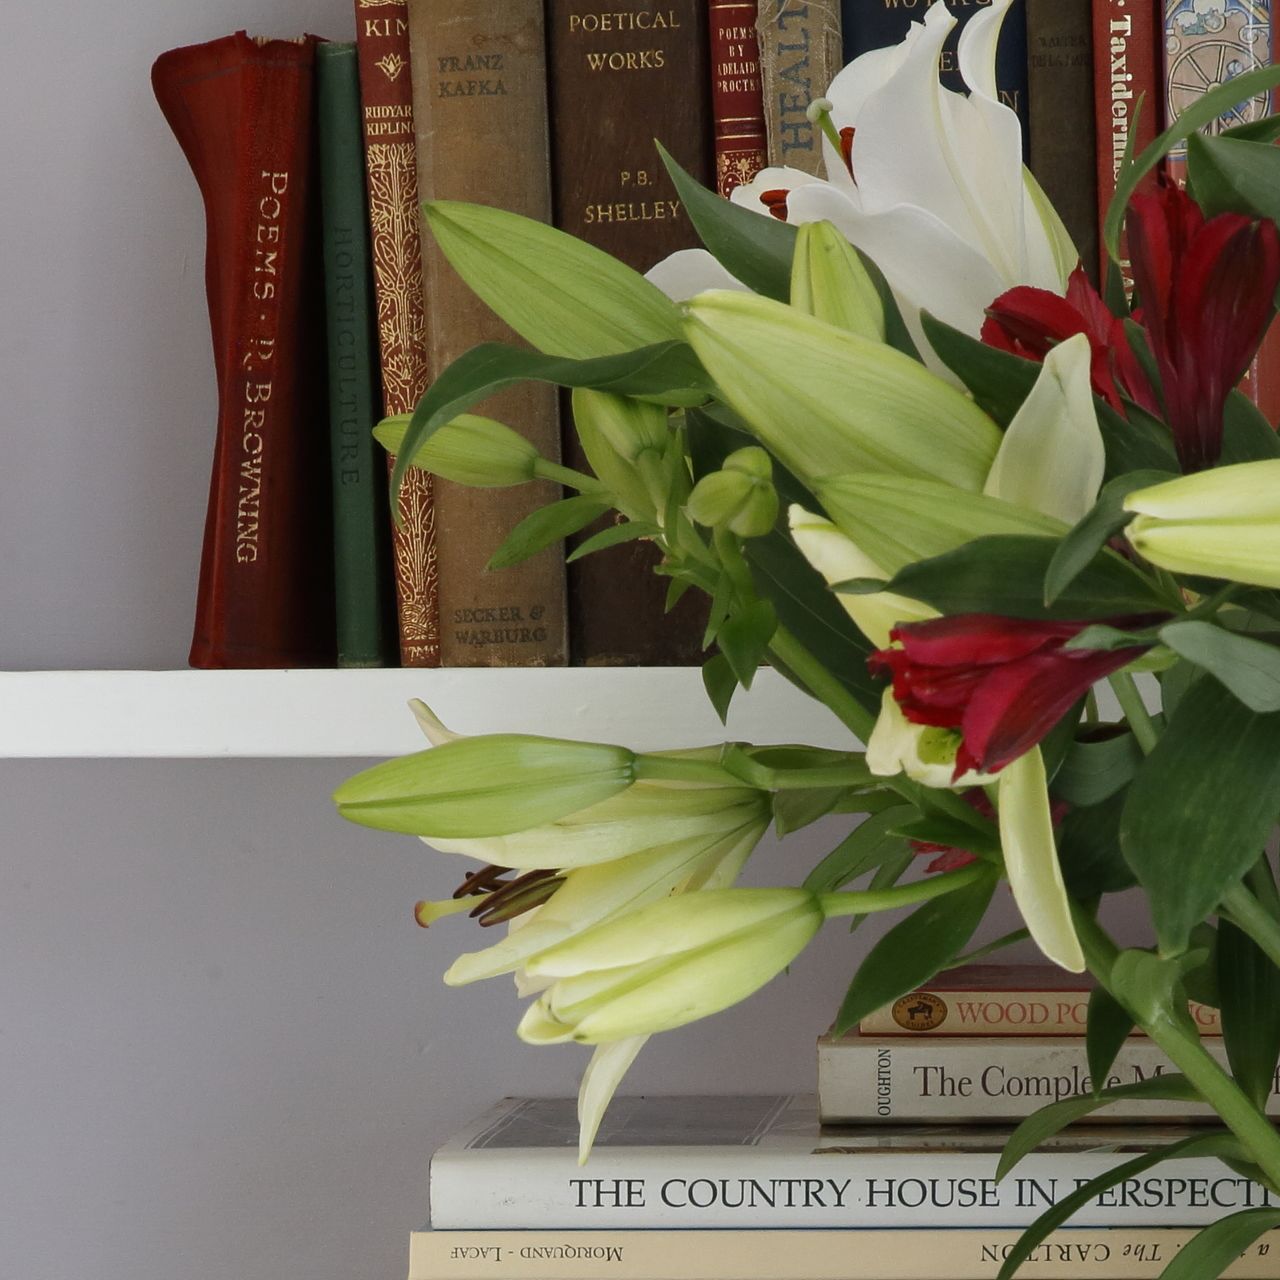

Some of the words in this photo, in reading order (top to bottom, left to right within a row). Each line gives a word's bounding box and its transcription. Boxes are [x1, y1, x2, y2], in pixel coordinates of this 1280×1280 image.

[569, 10, 681, 33] POETICAL
[719, 26, 754, 41] POEMS
[586, 49, 666, 73] WORKS
[728, 44, 745, 58] BY
[437, 53, 505, 74] FRANZ
[438, 77, 508, 99] KAFKA
[366, 121, 415, 136] KIPLIN
[620, 170, 654, 187] P.B.
[583, 199, 681, 225] SHELLEY
[252, 171, 289, 301] POEMS
[333, 226, 360, 486] HORTICULTURE
[236, 380, 273, 564] BROWNING
[455, 627, 548, 645] WARBURG
[956, 1001, 1050, 1025] WOOD
[877, 1048, 892, 1117] OUGHTON
[912, 1065, 973, 1097] The
[980, 1065, 1121, 1102] Complee
[569, 1178, 646, 1208] THE
[660, 1177, 851, 1209] COUNTRY
[865, 1177, 1003, 1209] HOUSE
[1014, 1178, 1057, 1209] IN
[449, 1244, 503, 1262] LACAF
[519, 1243, 624, 1263] MORIQUAND
[1121, 1243, 1162, 1261] The
